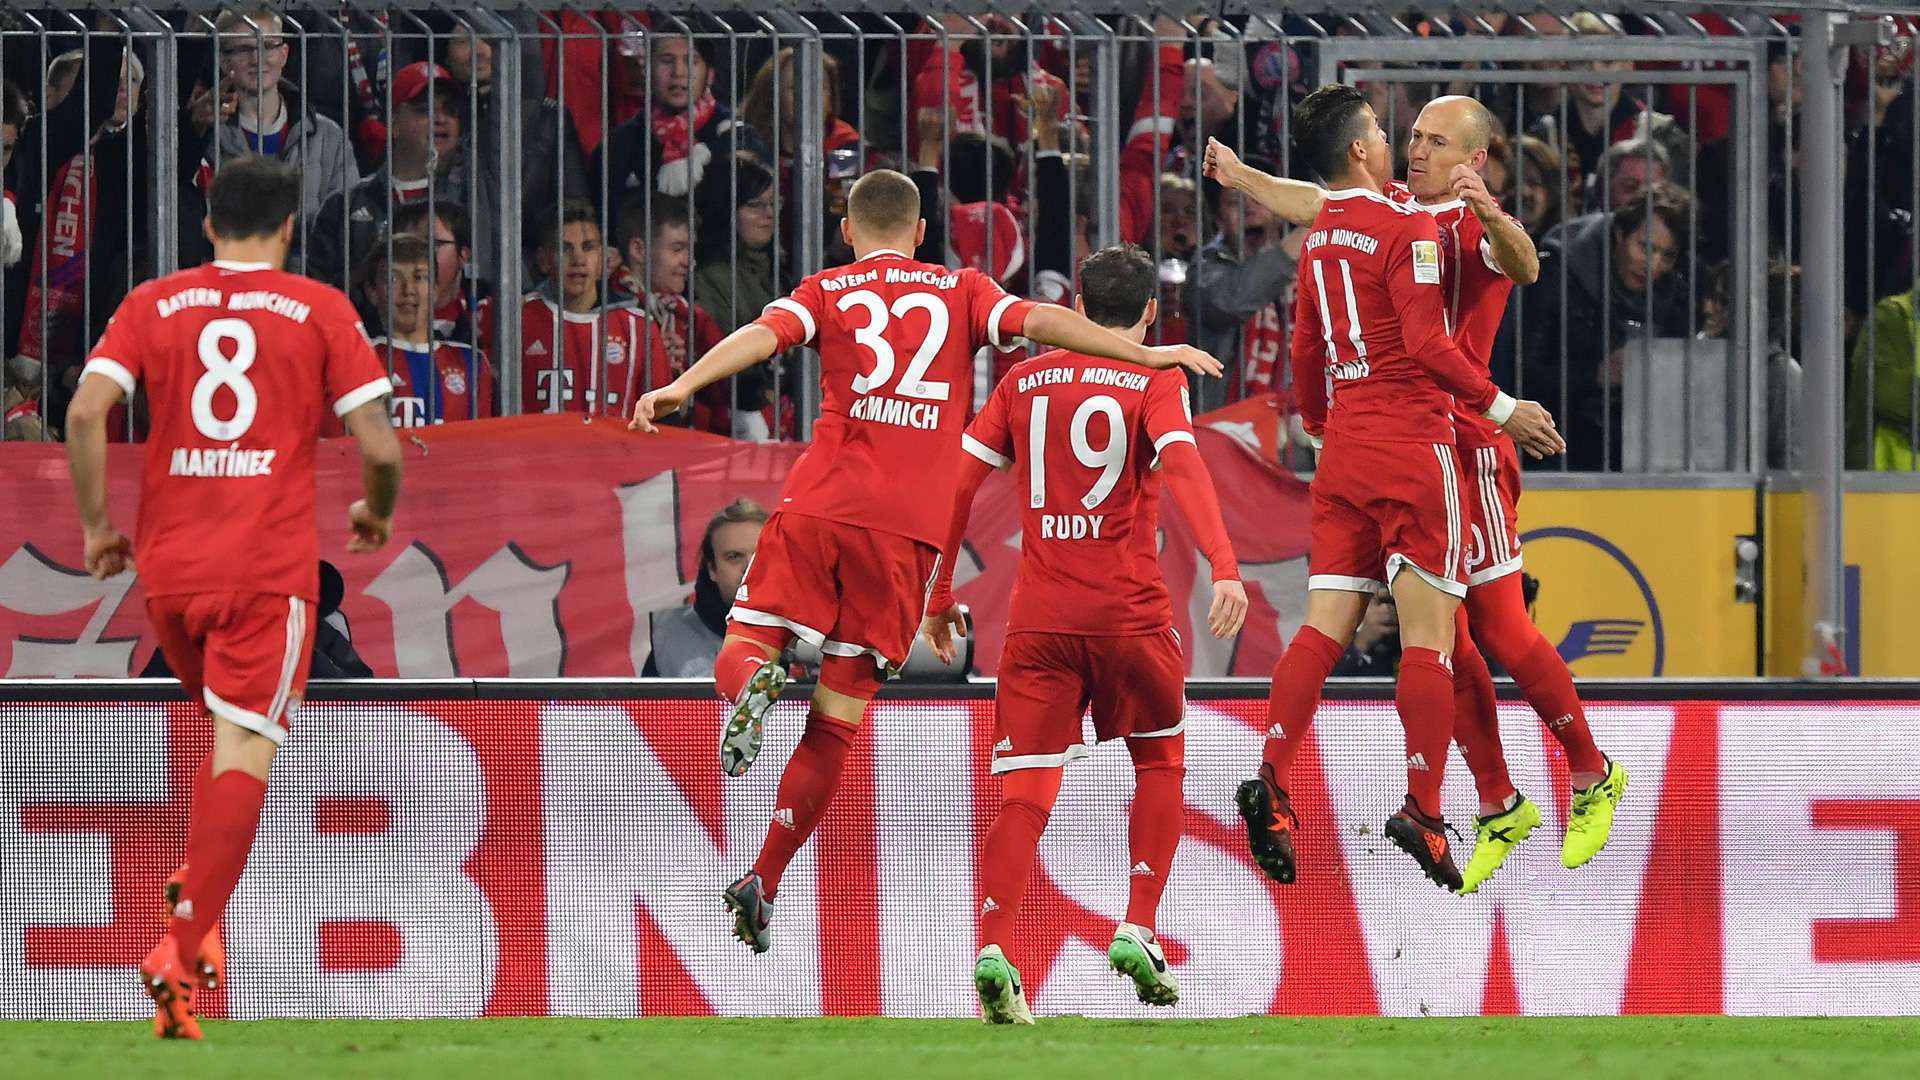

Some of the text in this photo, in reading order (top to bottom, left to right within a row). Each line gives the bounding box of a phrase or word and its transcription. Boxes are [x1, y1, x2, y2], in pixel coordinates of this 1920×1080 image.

[820, 269, 878, 292] BAYERN
[1313, 259, 1368, 363] 11
[191, 317, 258, 442] 8
[836, 290, 950, 401] 32
[1018, 367, 1075, 393] BAYERN
[169, 441, 277, 478] MARTÍNEZ
[1029, 395, 1128, 511] 19
[1041, 514, 1104, 540] RUDY
